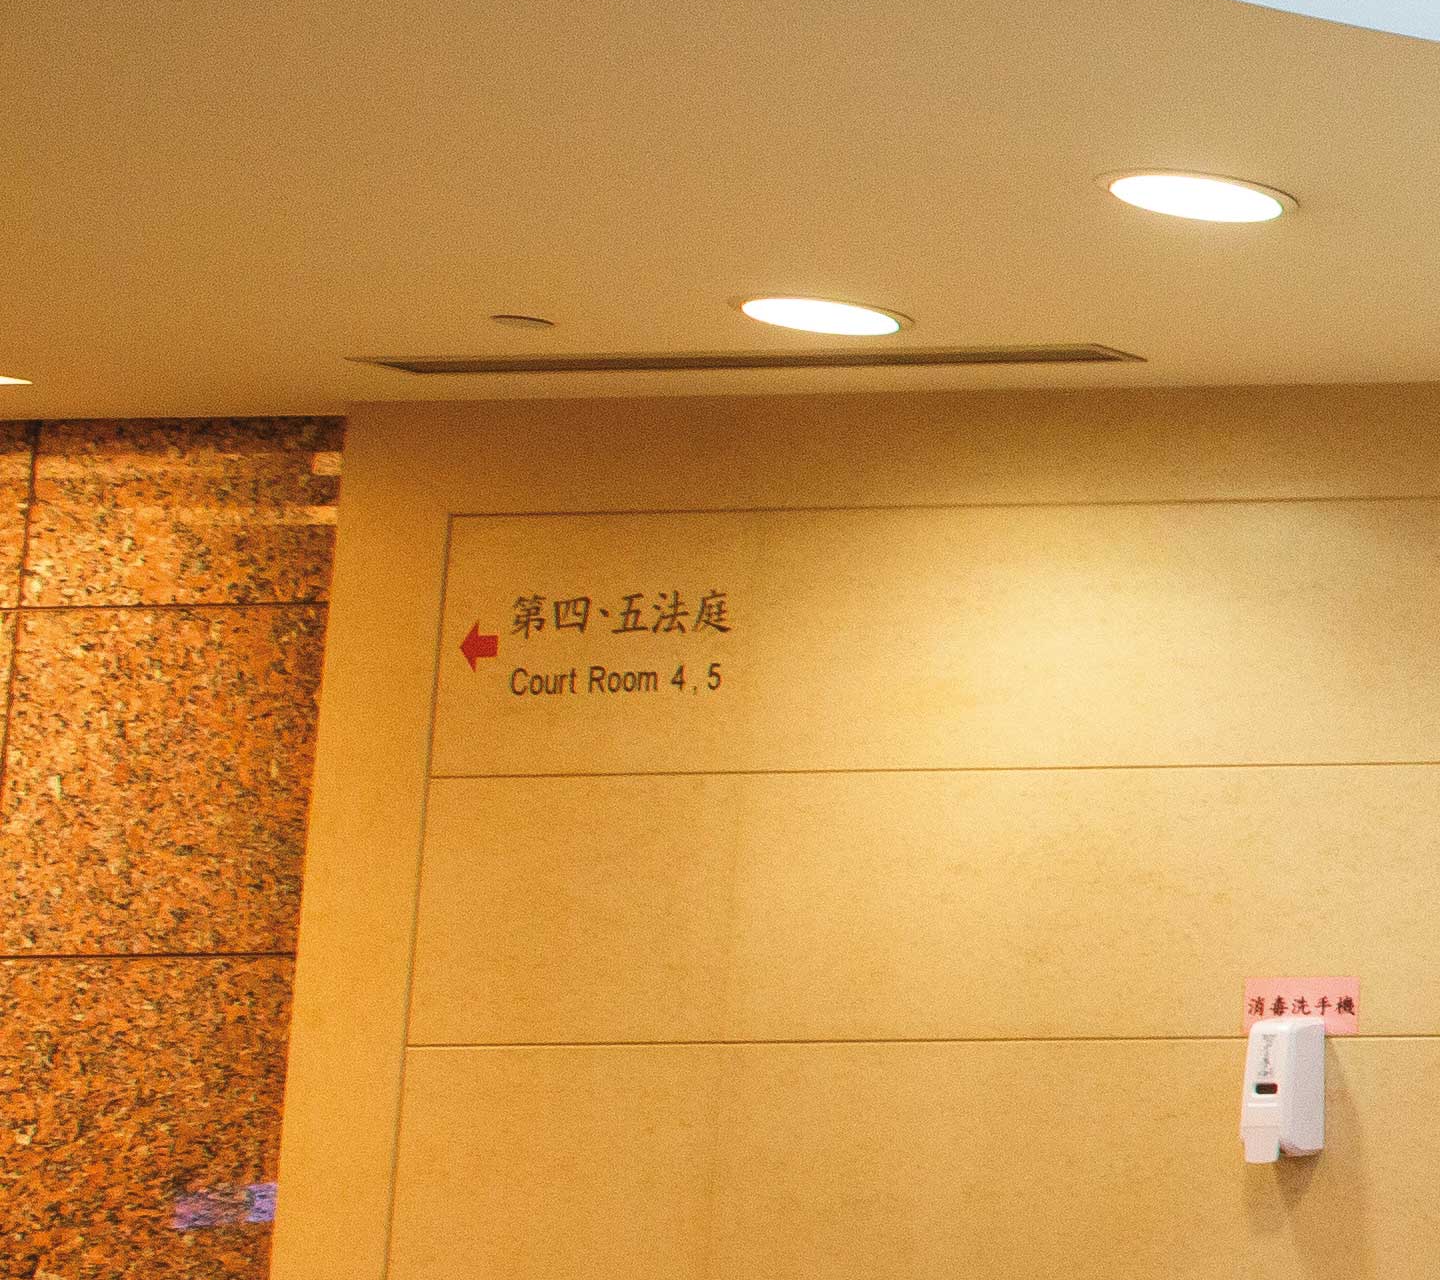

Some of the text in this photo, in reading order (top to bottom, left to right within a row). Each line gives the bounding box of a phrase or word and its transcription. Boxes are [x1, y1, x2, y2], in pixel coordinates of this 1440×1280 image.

[510, 667, 577, 696] Court
[588, 665, 658, 694] Room
[1248, 995, 1355, 1016] 消毒洗手機
